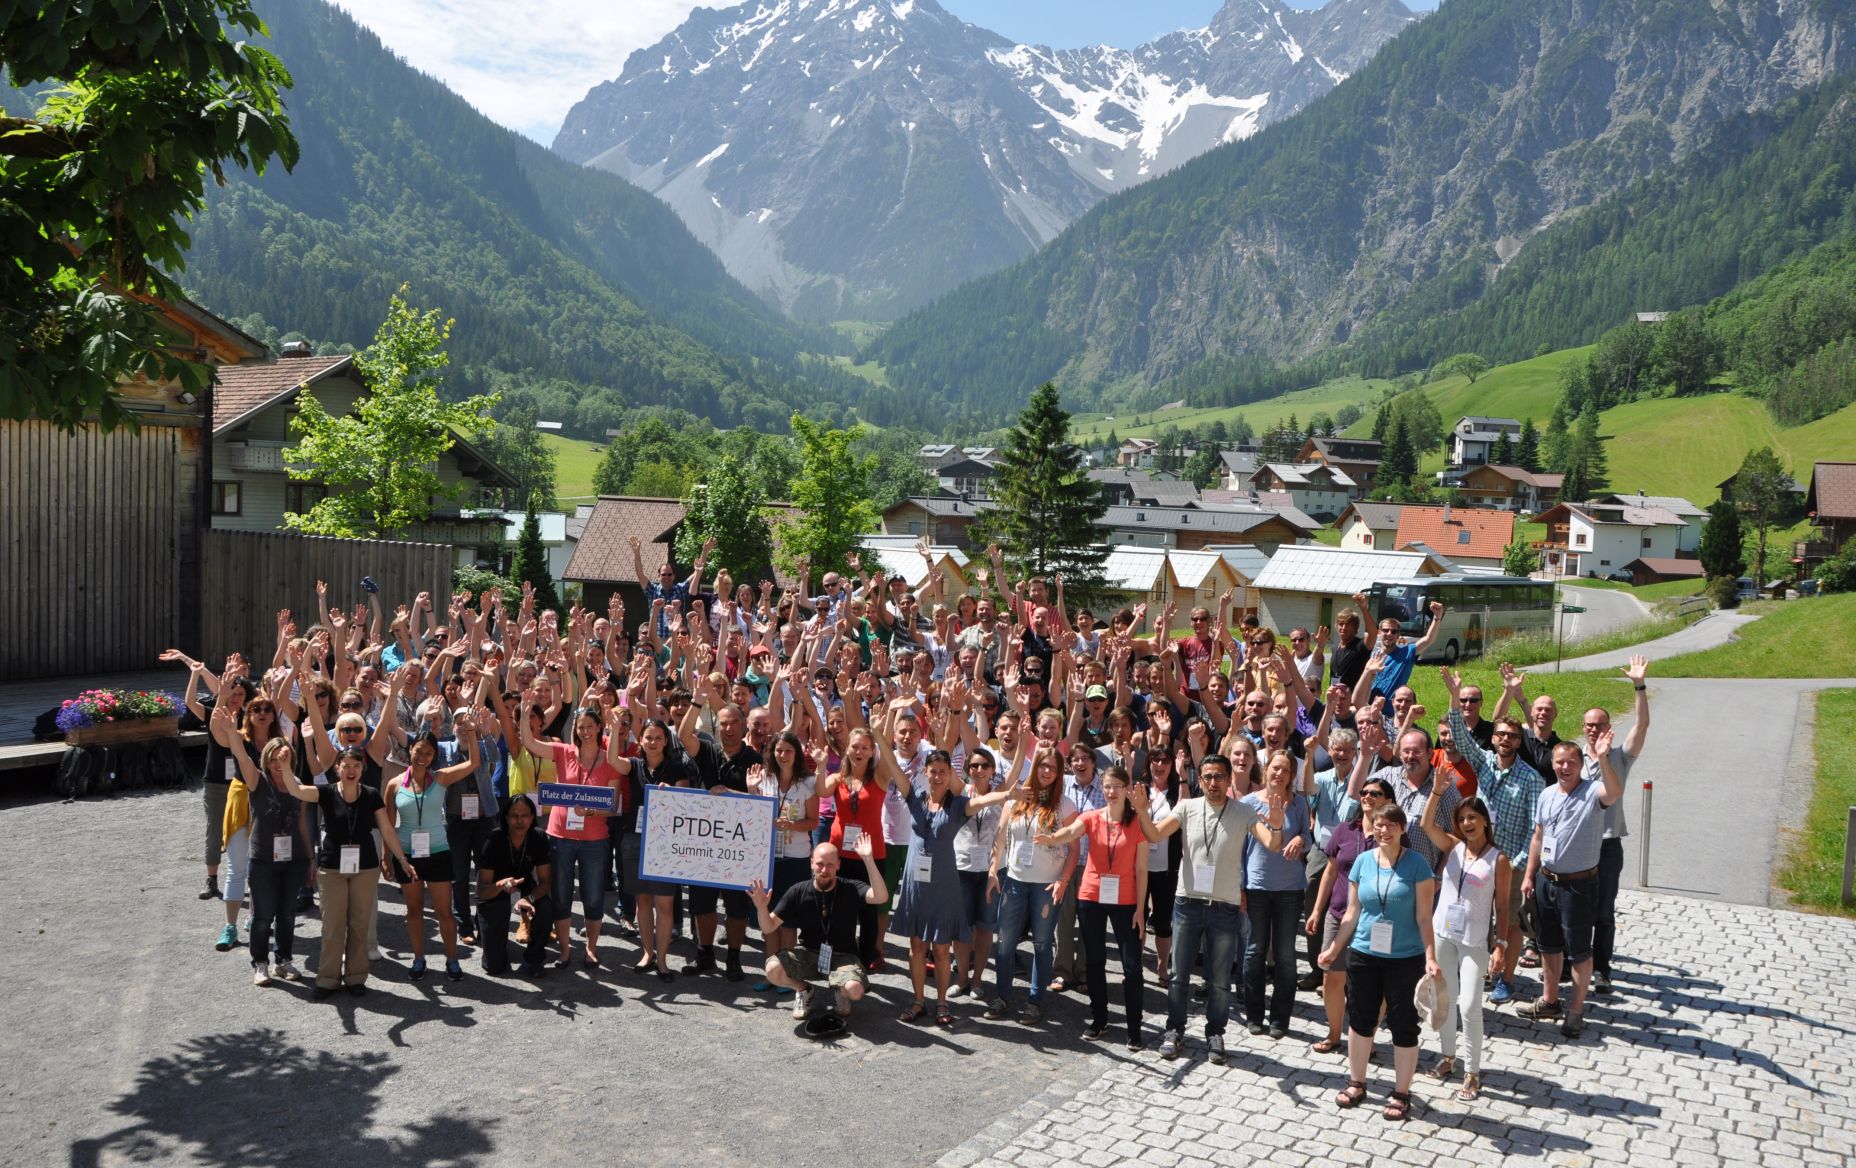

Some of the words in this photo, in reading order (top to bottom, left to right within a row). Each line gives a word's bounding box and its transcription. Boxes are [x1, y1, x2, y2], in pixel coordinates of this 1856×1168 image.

[542, 789, 560, 799] Platz
[561, 791, 574, 800] der
[575, 792, 612, 806] Zulassung
[672, 816, 746, 841] PTDE-A
[671, 843, 714, 859] Summit
[717, 848, 745, 862] 2015
